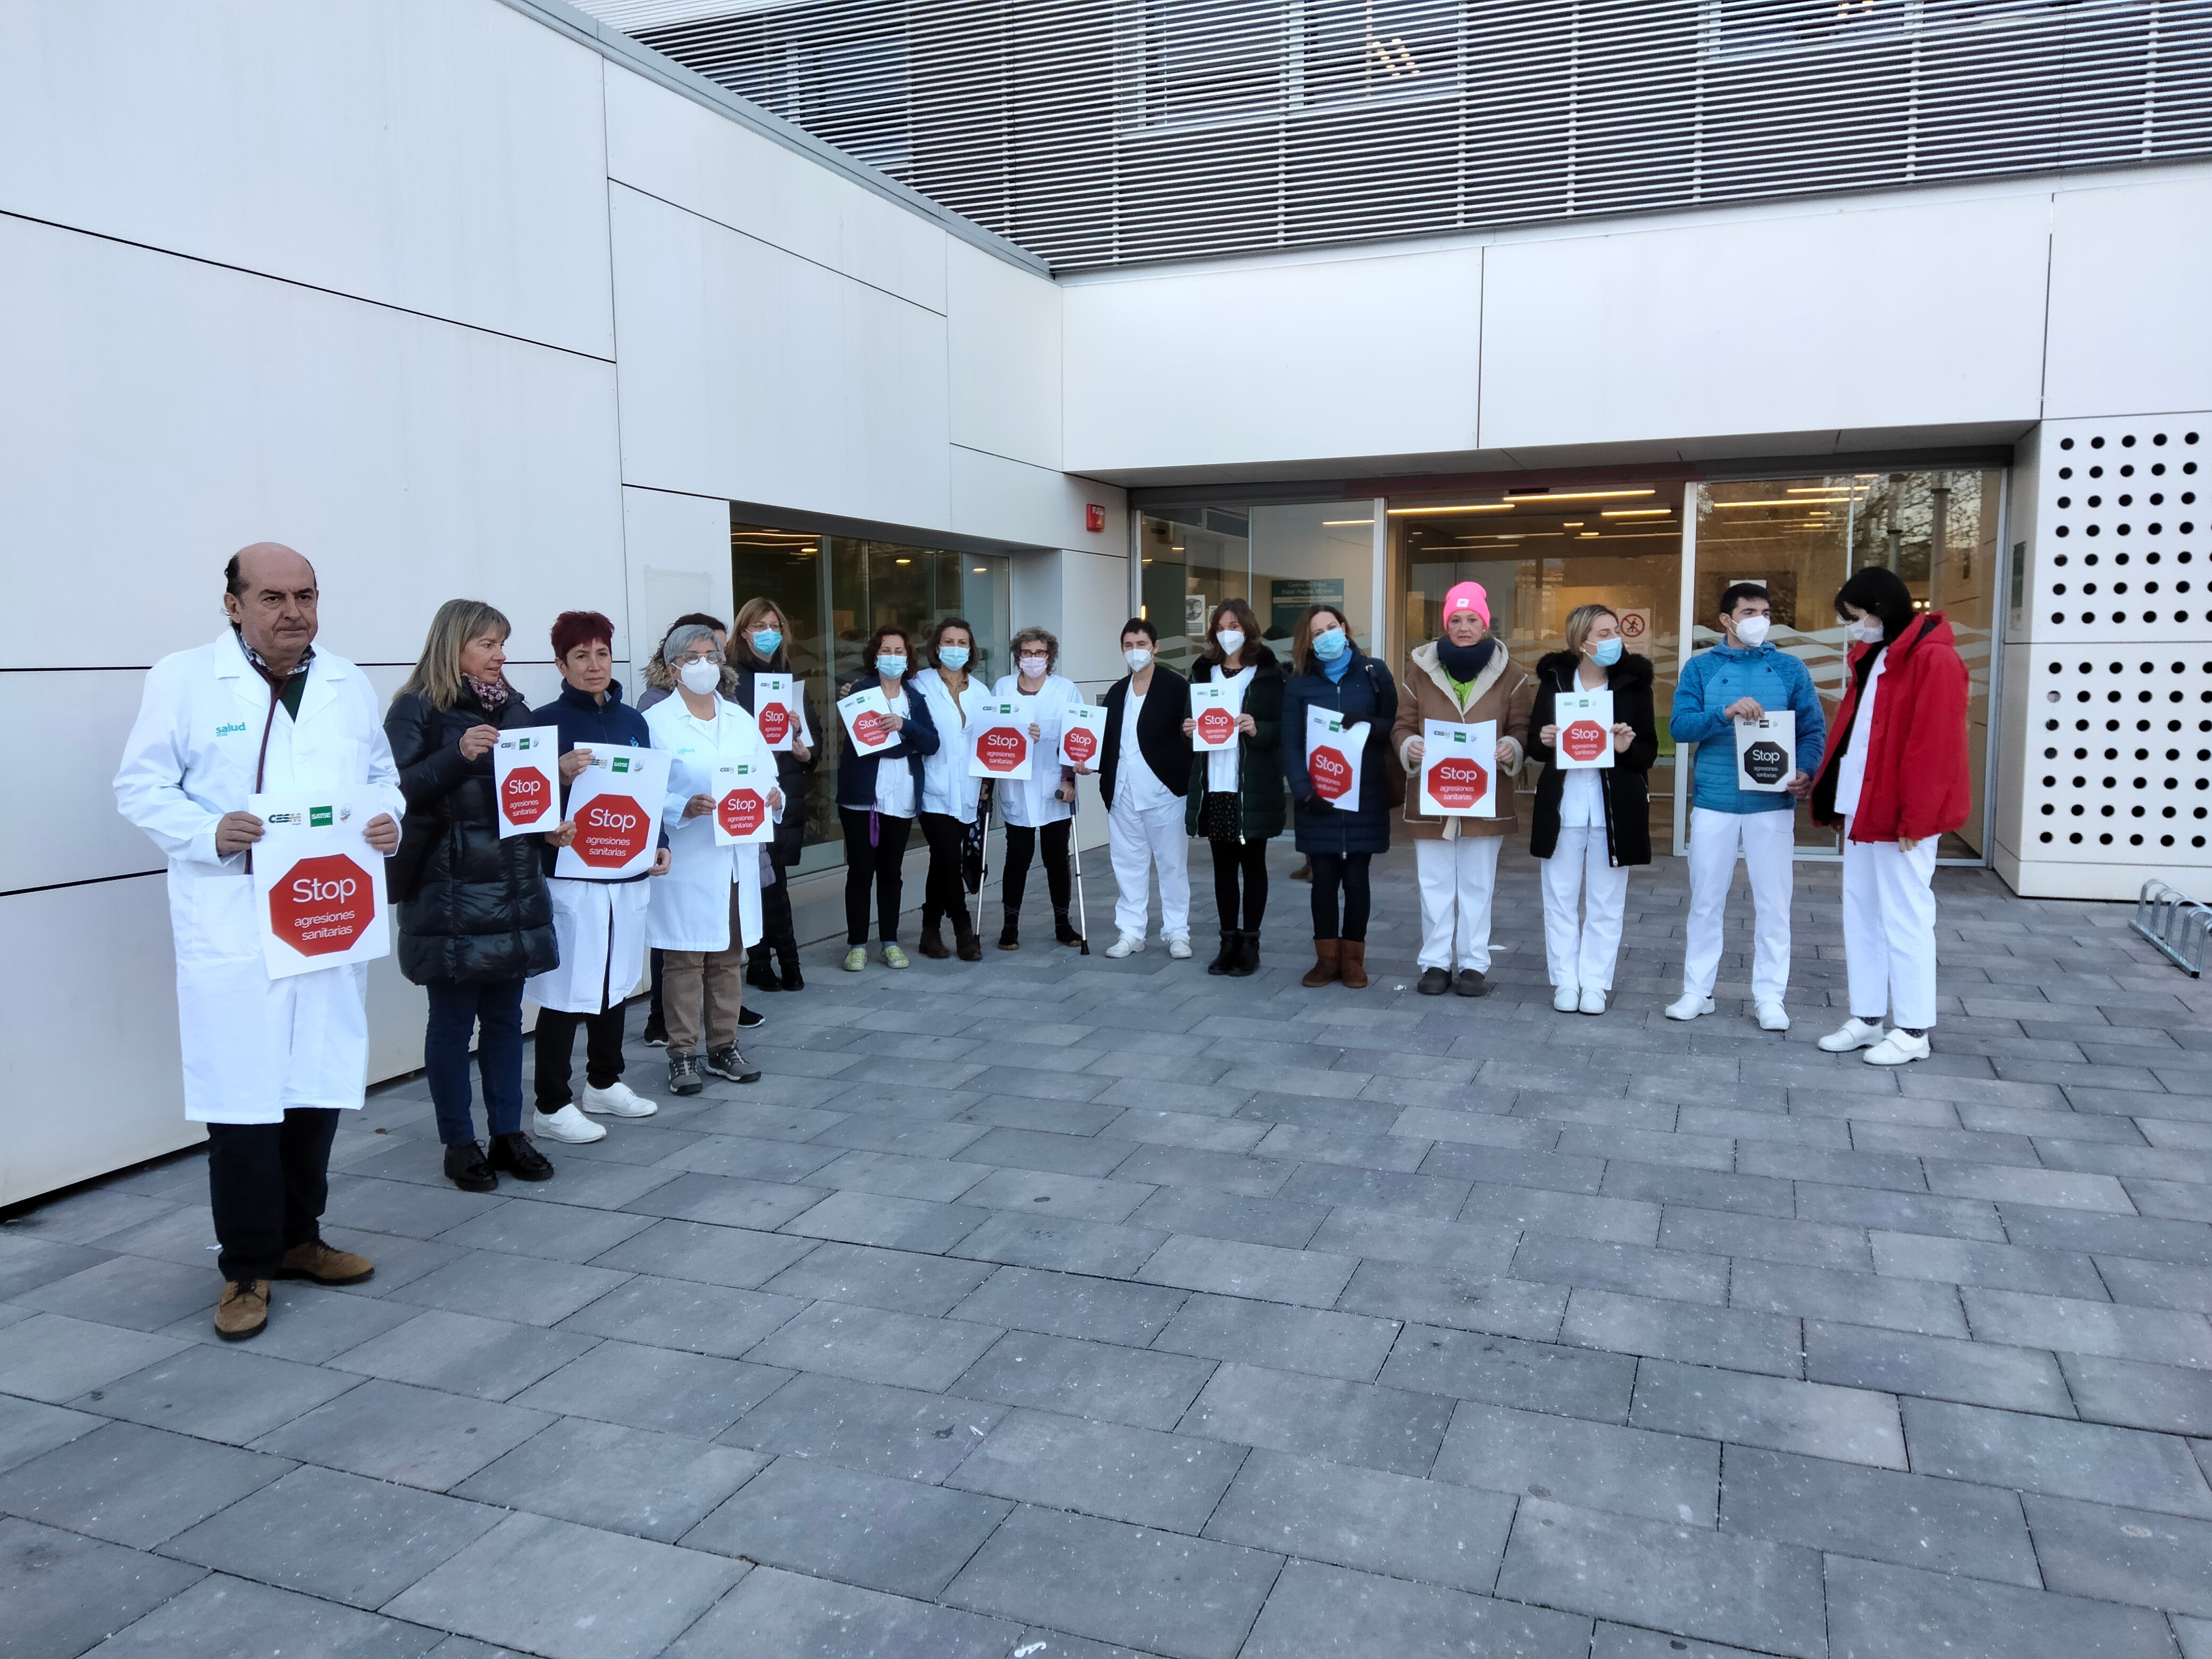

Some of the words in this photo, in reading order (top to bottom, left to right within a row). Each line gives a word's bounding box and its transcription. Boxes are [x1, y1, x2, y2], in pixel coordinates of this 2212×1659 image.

[765, 710, 784, 724] Stop
[1205, 715, 1228, 726] Stop
[216, 722, 246, 733] salud
[1571, 728, 1599, 741] Stop
[987, 734, 1018, 749] Stop
[1070, 733, 1091, 746] Stop
[1753, 749, 1780, 764] Stop
[1316, 754, 1344, 776] Stop
[1440, 767, 1477, 783] Stop
[509, 780, 540, 795] Stop
[510, 800, 539, 809] agresiones
[727, 799, 756, 812] Stop
[589, 808, 636, 833] Stop
[586, 836, 630, 845] agresiones
[589, 848, 626, 857] sanitarias
[293, 878, 356, 903] Stop
[294, 910, 355, 928] agresiones
[302, 926, 353, 940] sanitarias
